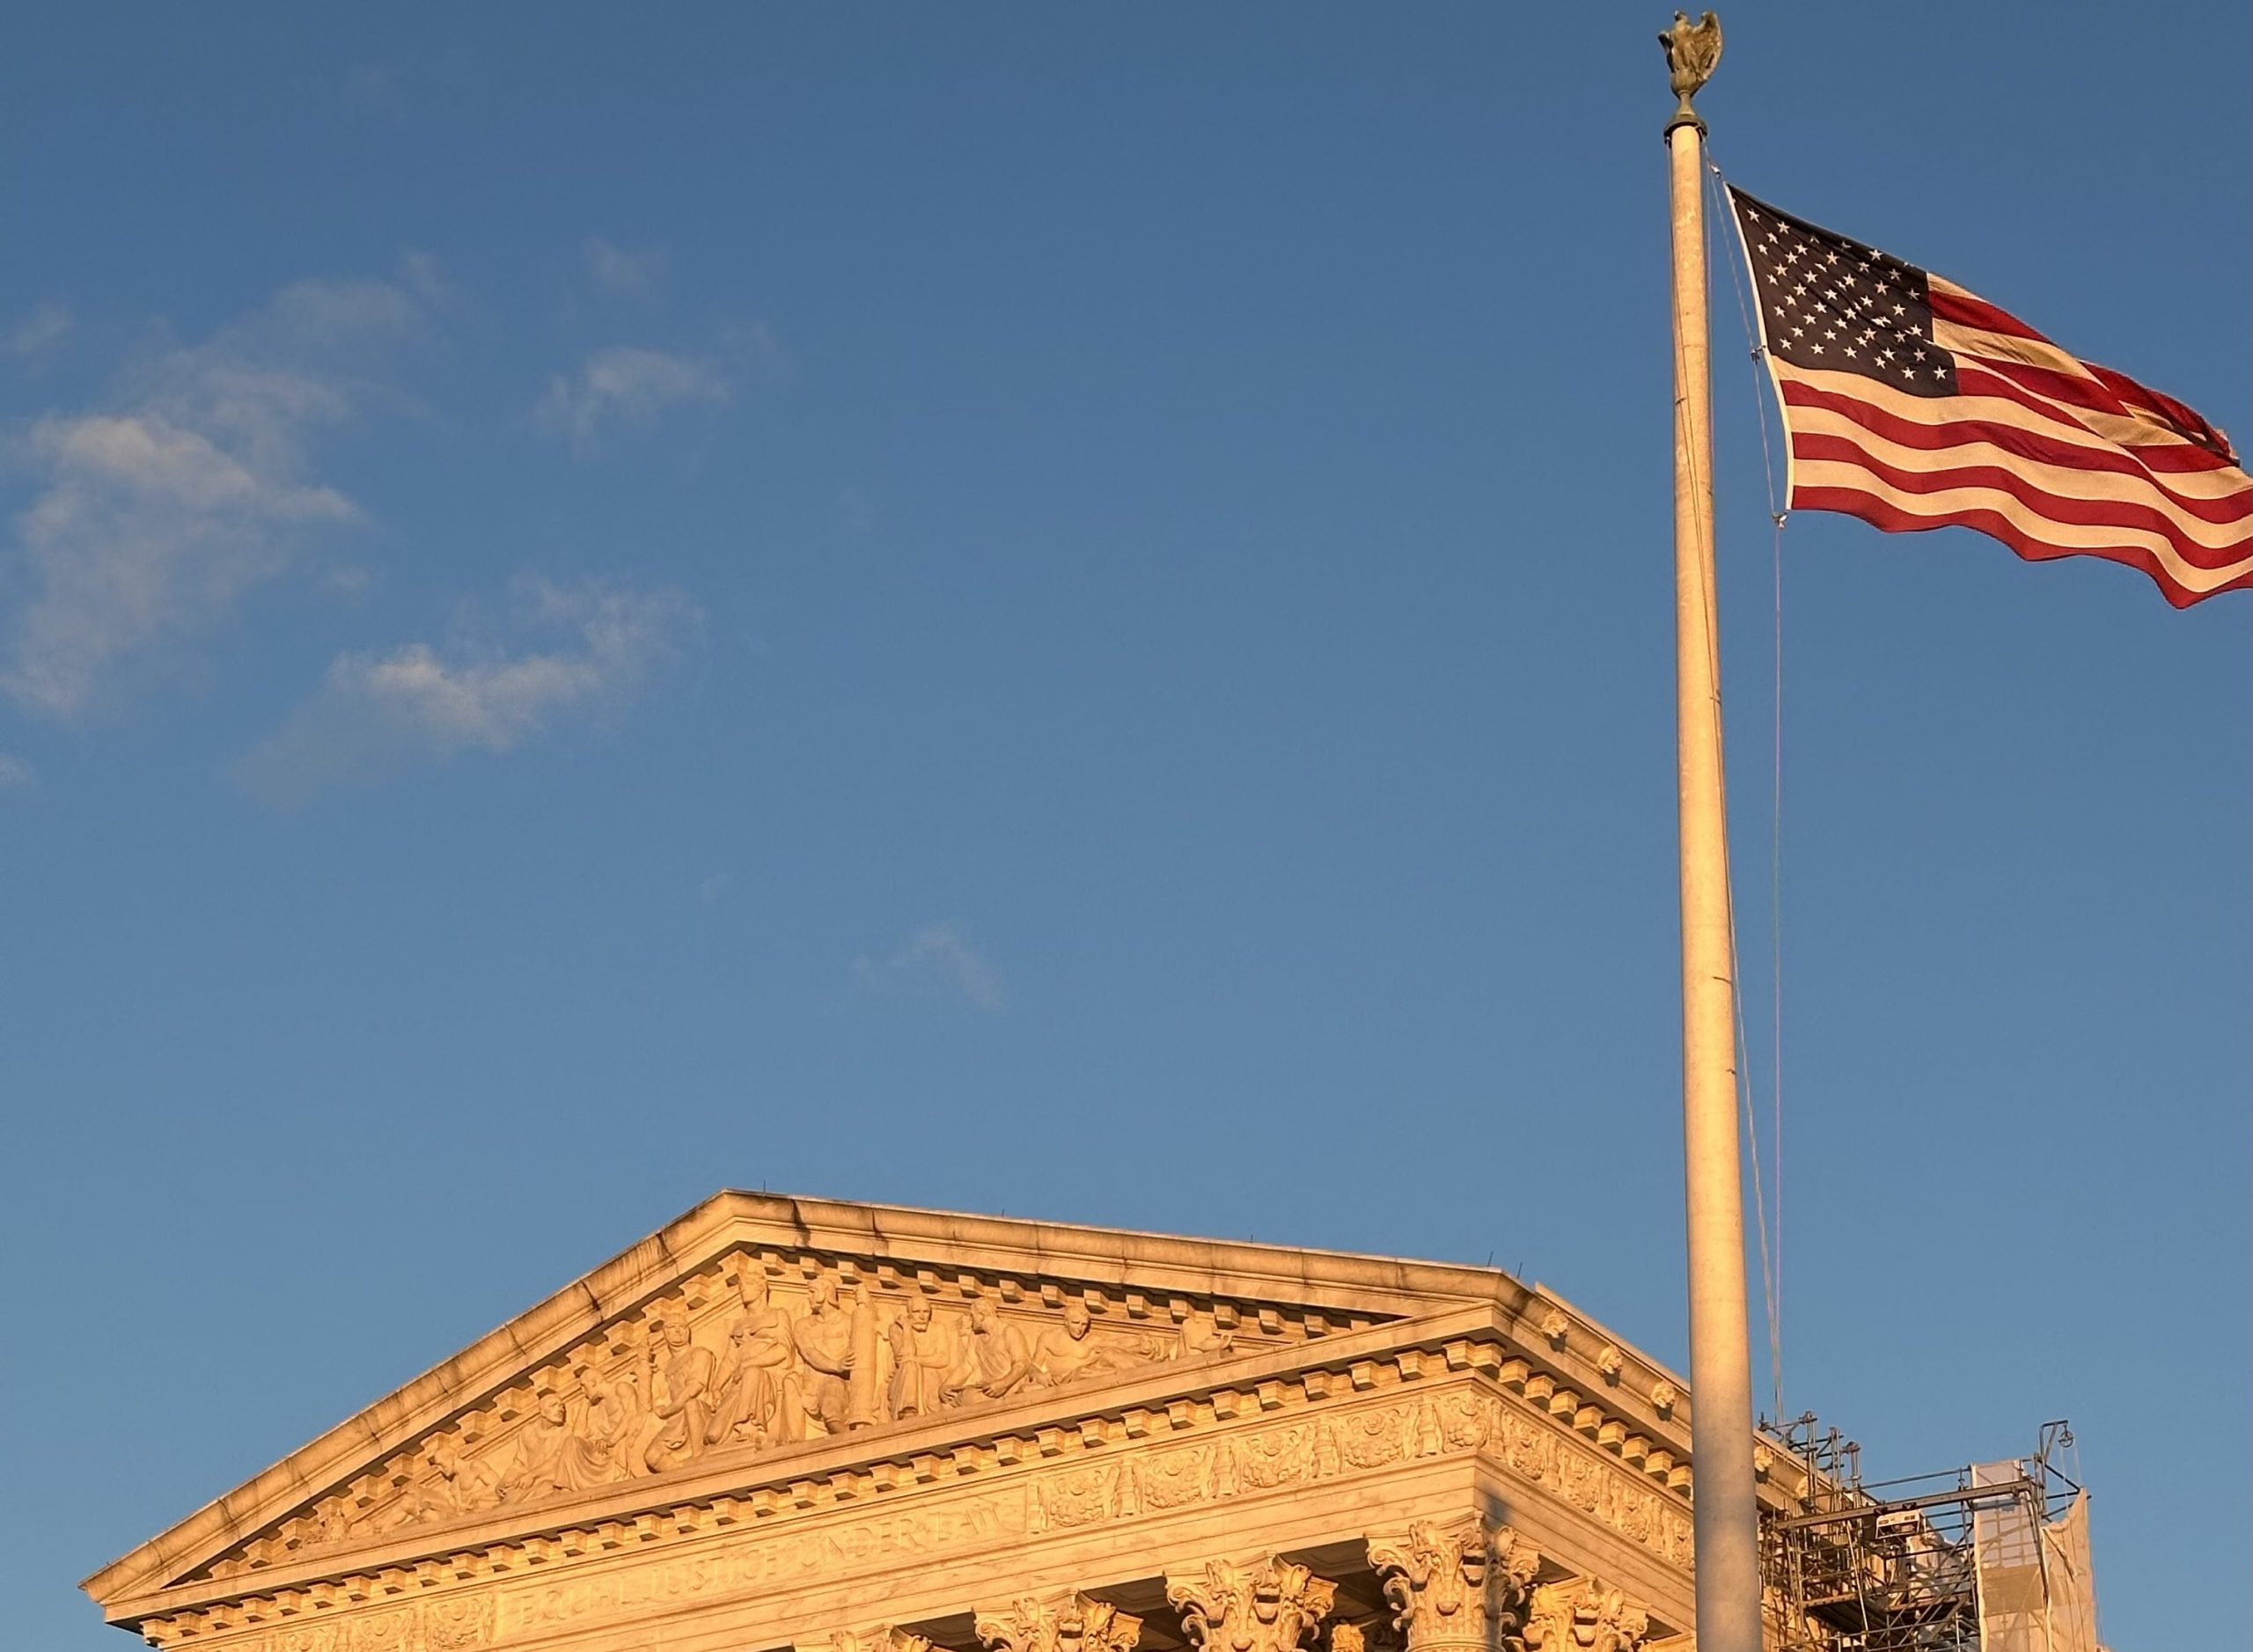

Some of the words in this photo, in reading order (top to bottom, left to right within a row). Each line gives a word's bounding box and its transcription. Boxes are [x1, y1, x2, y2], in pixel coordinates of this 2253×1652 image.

[519, 1575, 635, 1625] EQUAL
[642, 1545, 778, 1601] JUSTICE
[798, 1517, 927, 1568] UNDER
[936, 1500, 1005, 1542] LAW
